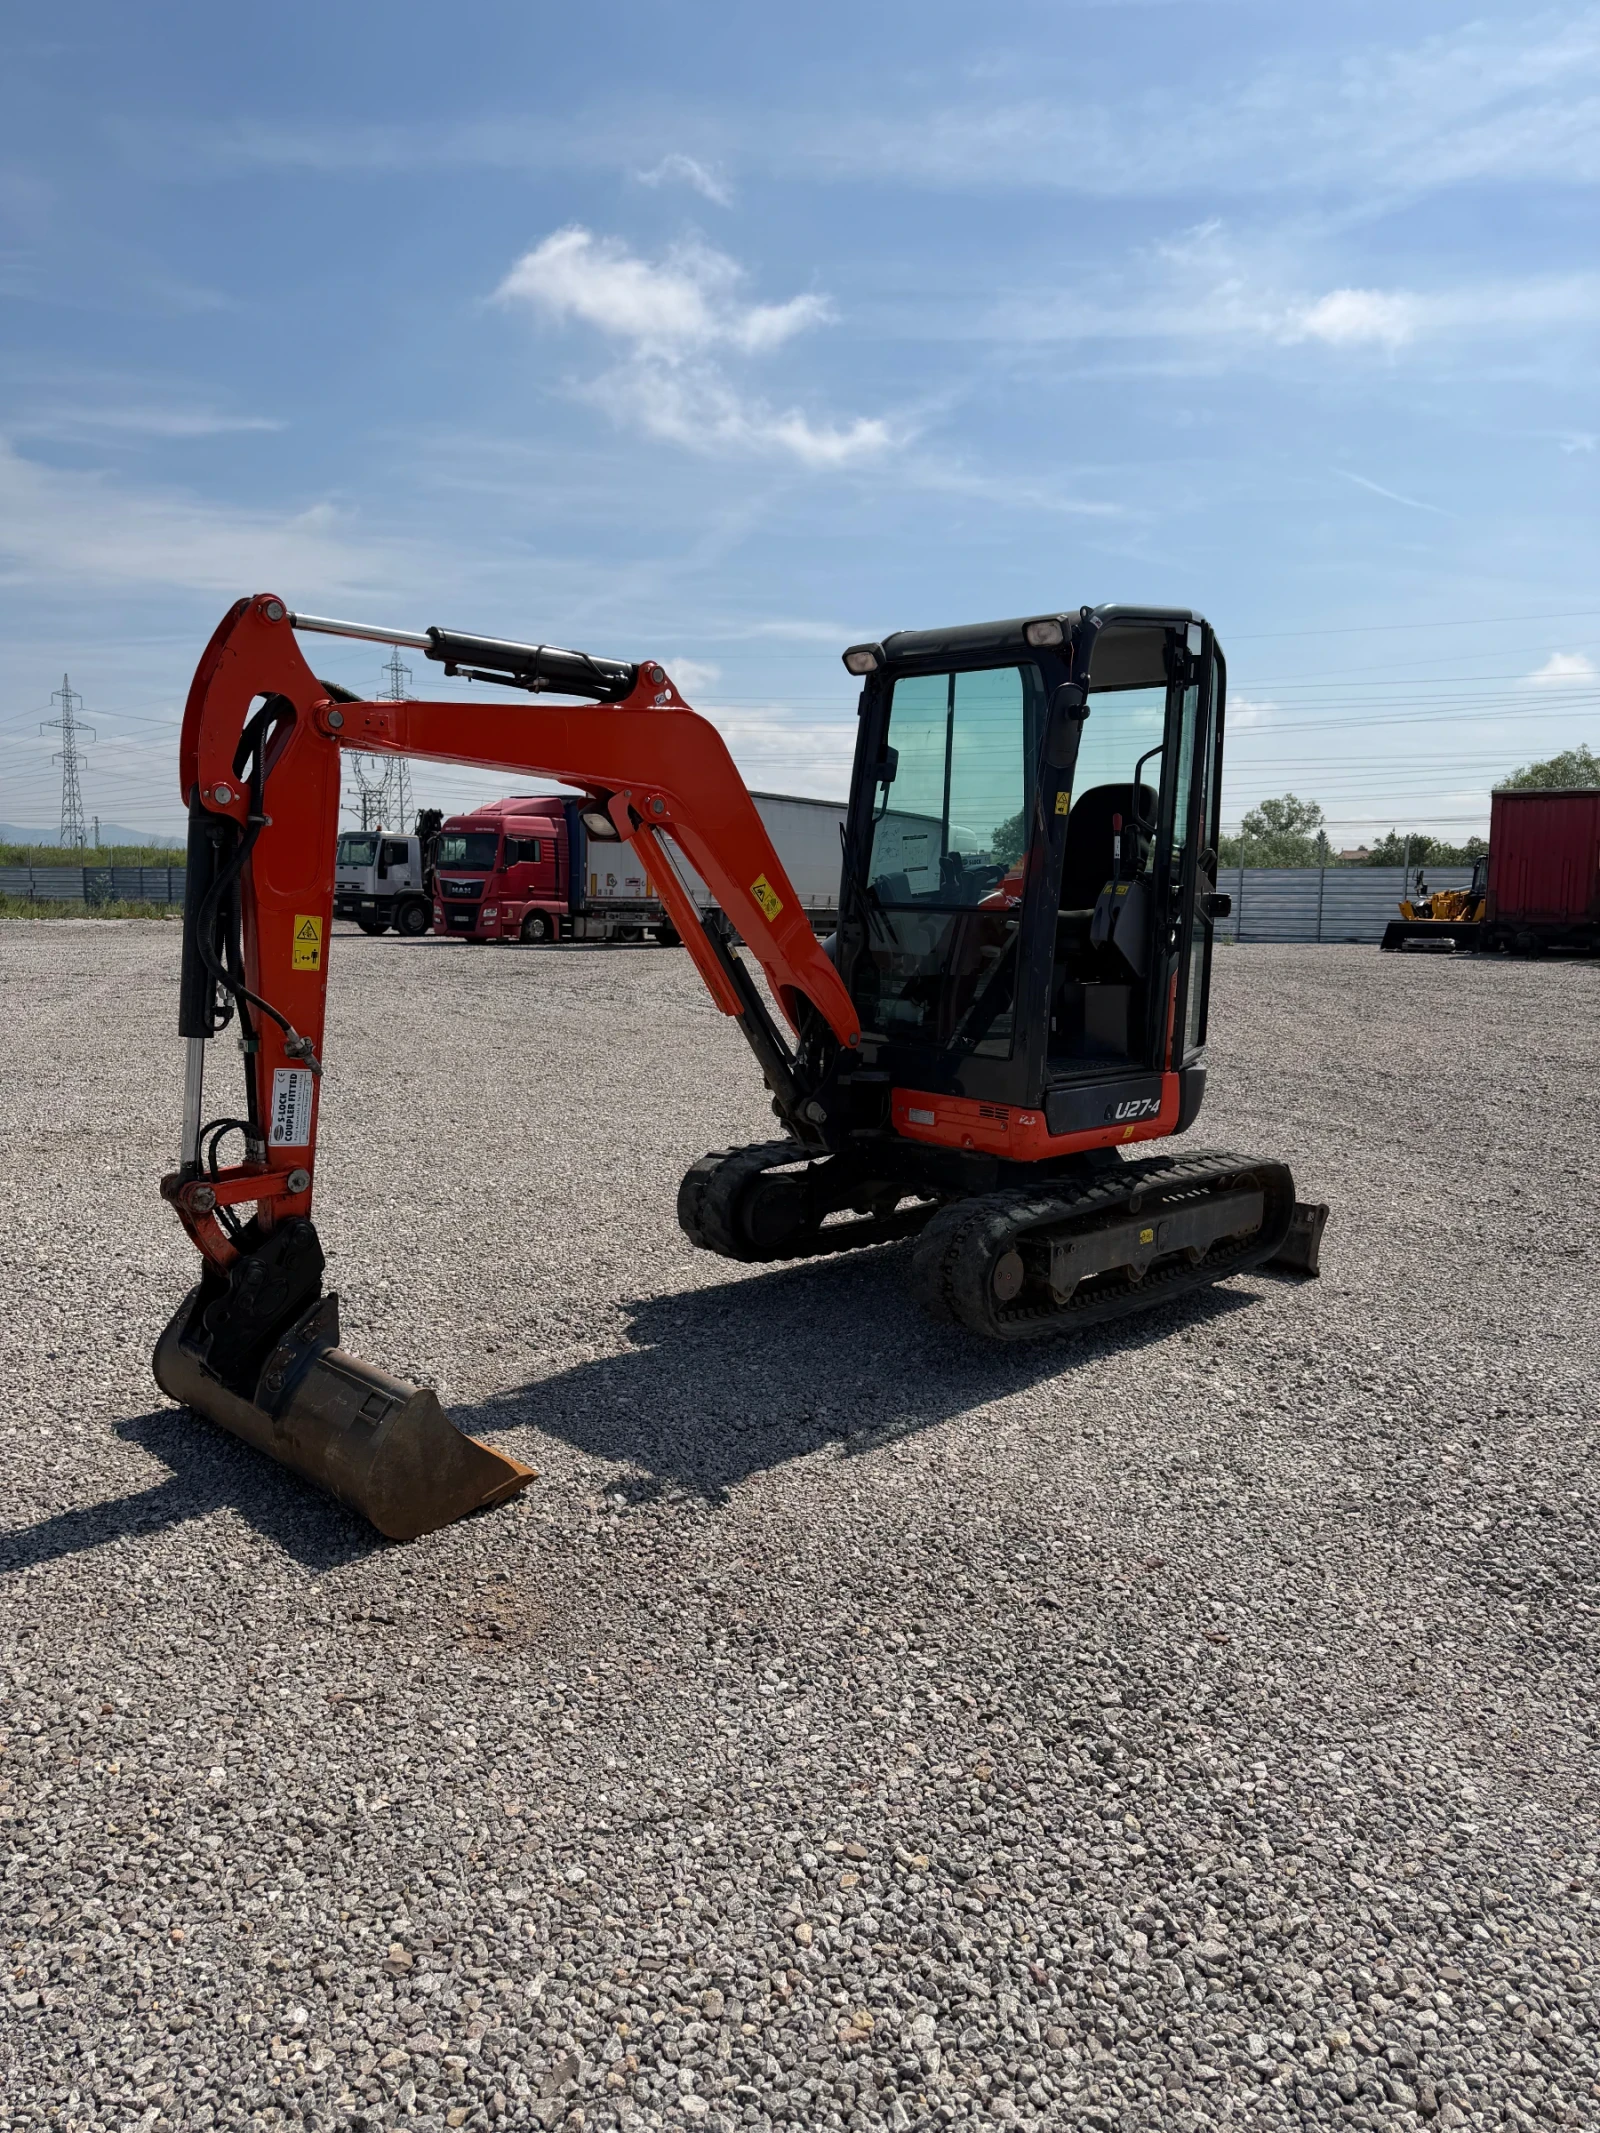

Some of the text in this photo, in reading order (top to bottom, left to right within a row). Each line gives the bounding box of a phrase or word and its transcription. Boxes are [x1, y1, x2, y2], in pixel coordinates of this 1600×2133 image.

[278, 1072, 285, 1083] CE
[278, 1092, 287, 1122] S-LOCK
[285, 1073, 298, 1141] COUPLER FITTED
[1115, 1098, 1161, 1119] U27-4
